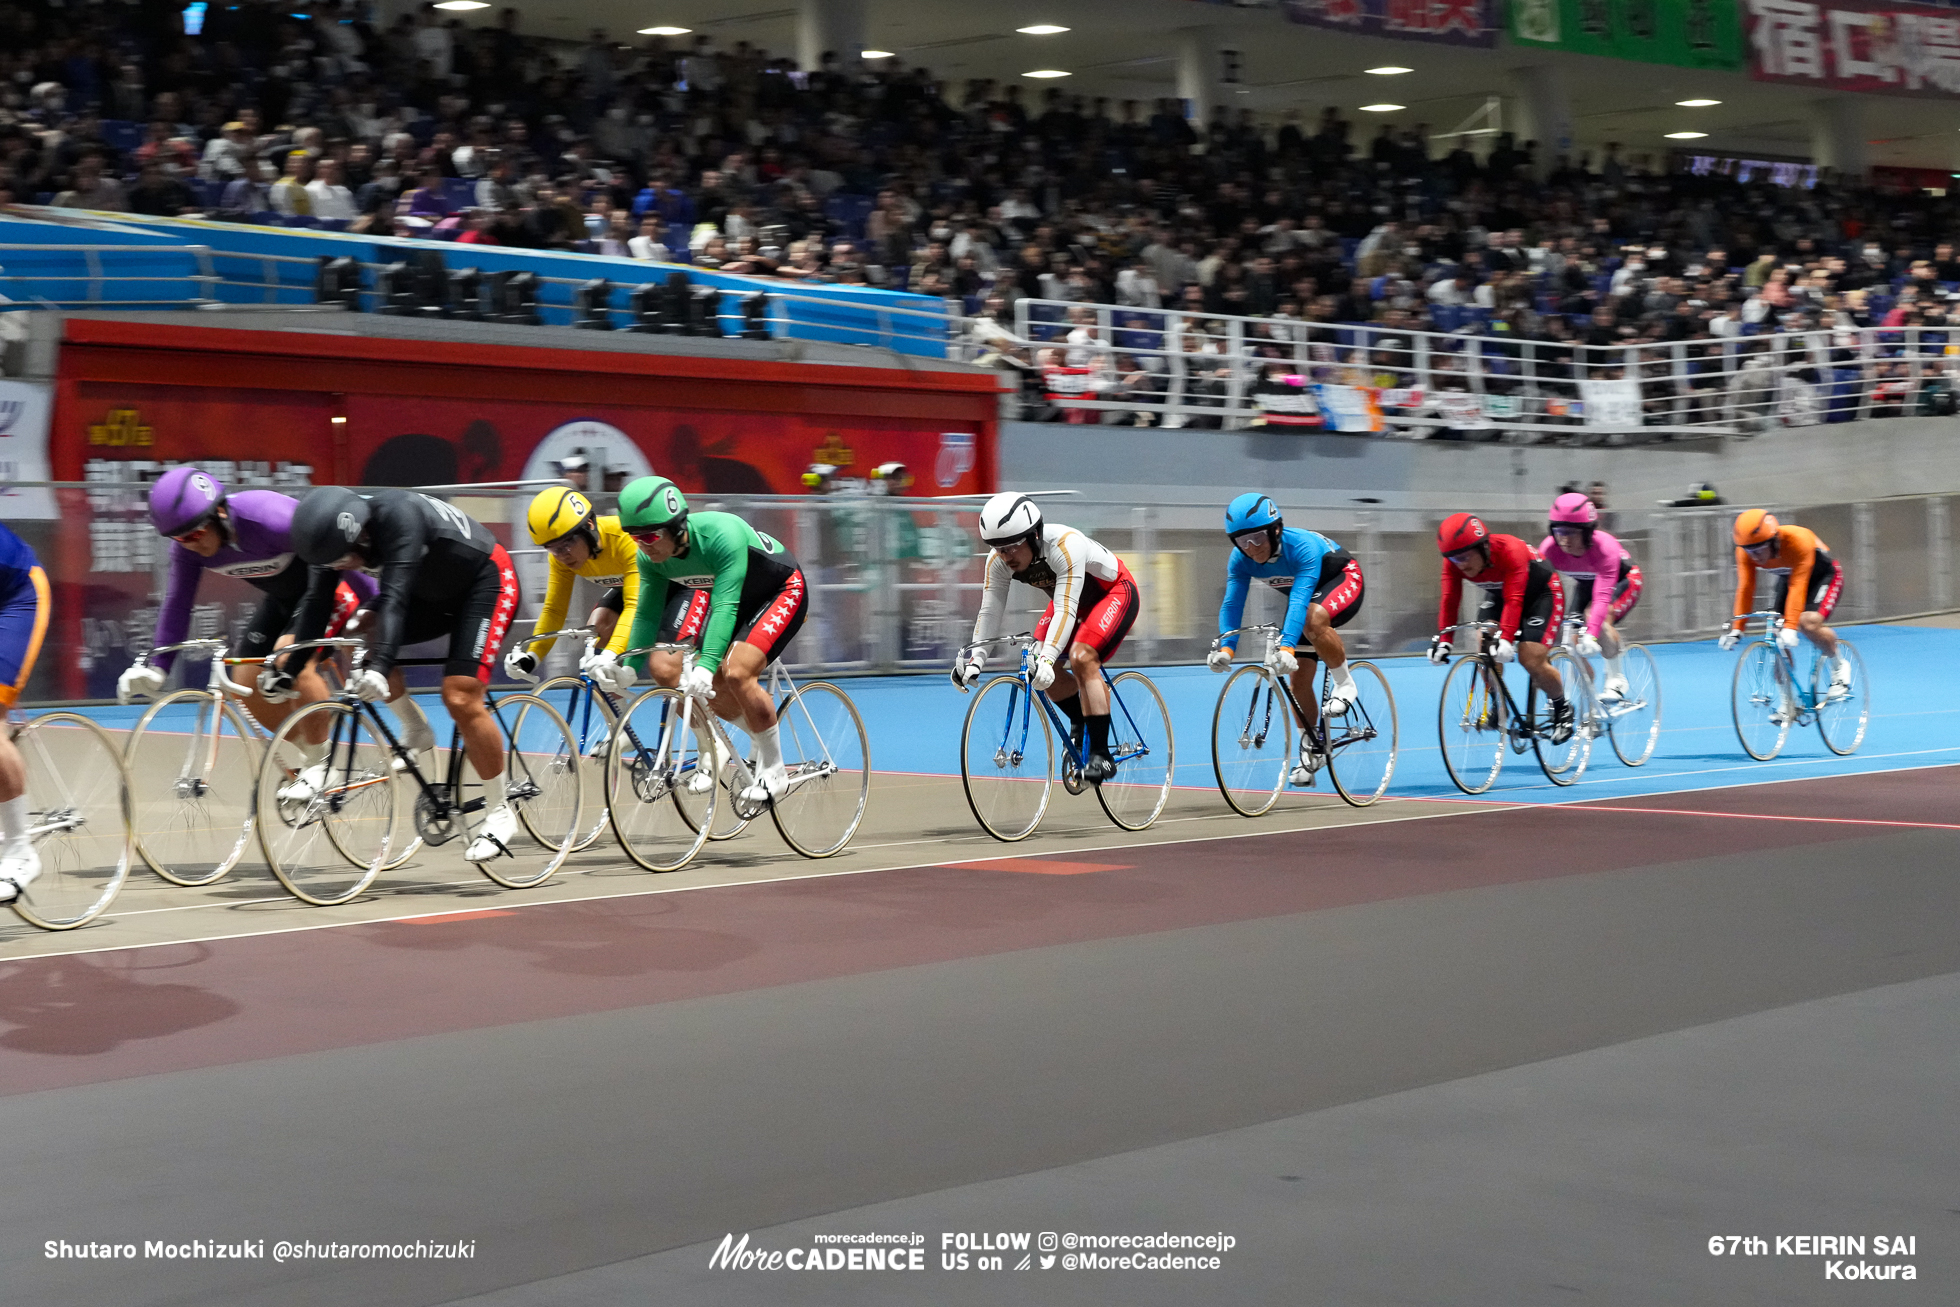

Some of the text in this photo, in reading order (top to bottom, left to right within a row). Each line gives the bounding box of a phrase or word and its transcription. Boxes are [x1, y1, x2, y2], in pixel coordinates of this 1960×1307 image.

[190, 474, 217, 501] 9
[568, 493, 586, 518] 5
[664, 488, 682, 515] 6
[1267, 498, 1279, 520] 4
[1470, 518, 1485, 537] 3
[594, 577, 624, 585] KEIRI
[1269, 577, 1294, 585] KEIR
[1098, 597, 1122, 632] KEIRIN
